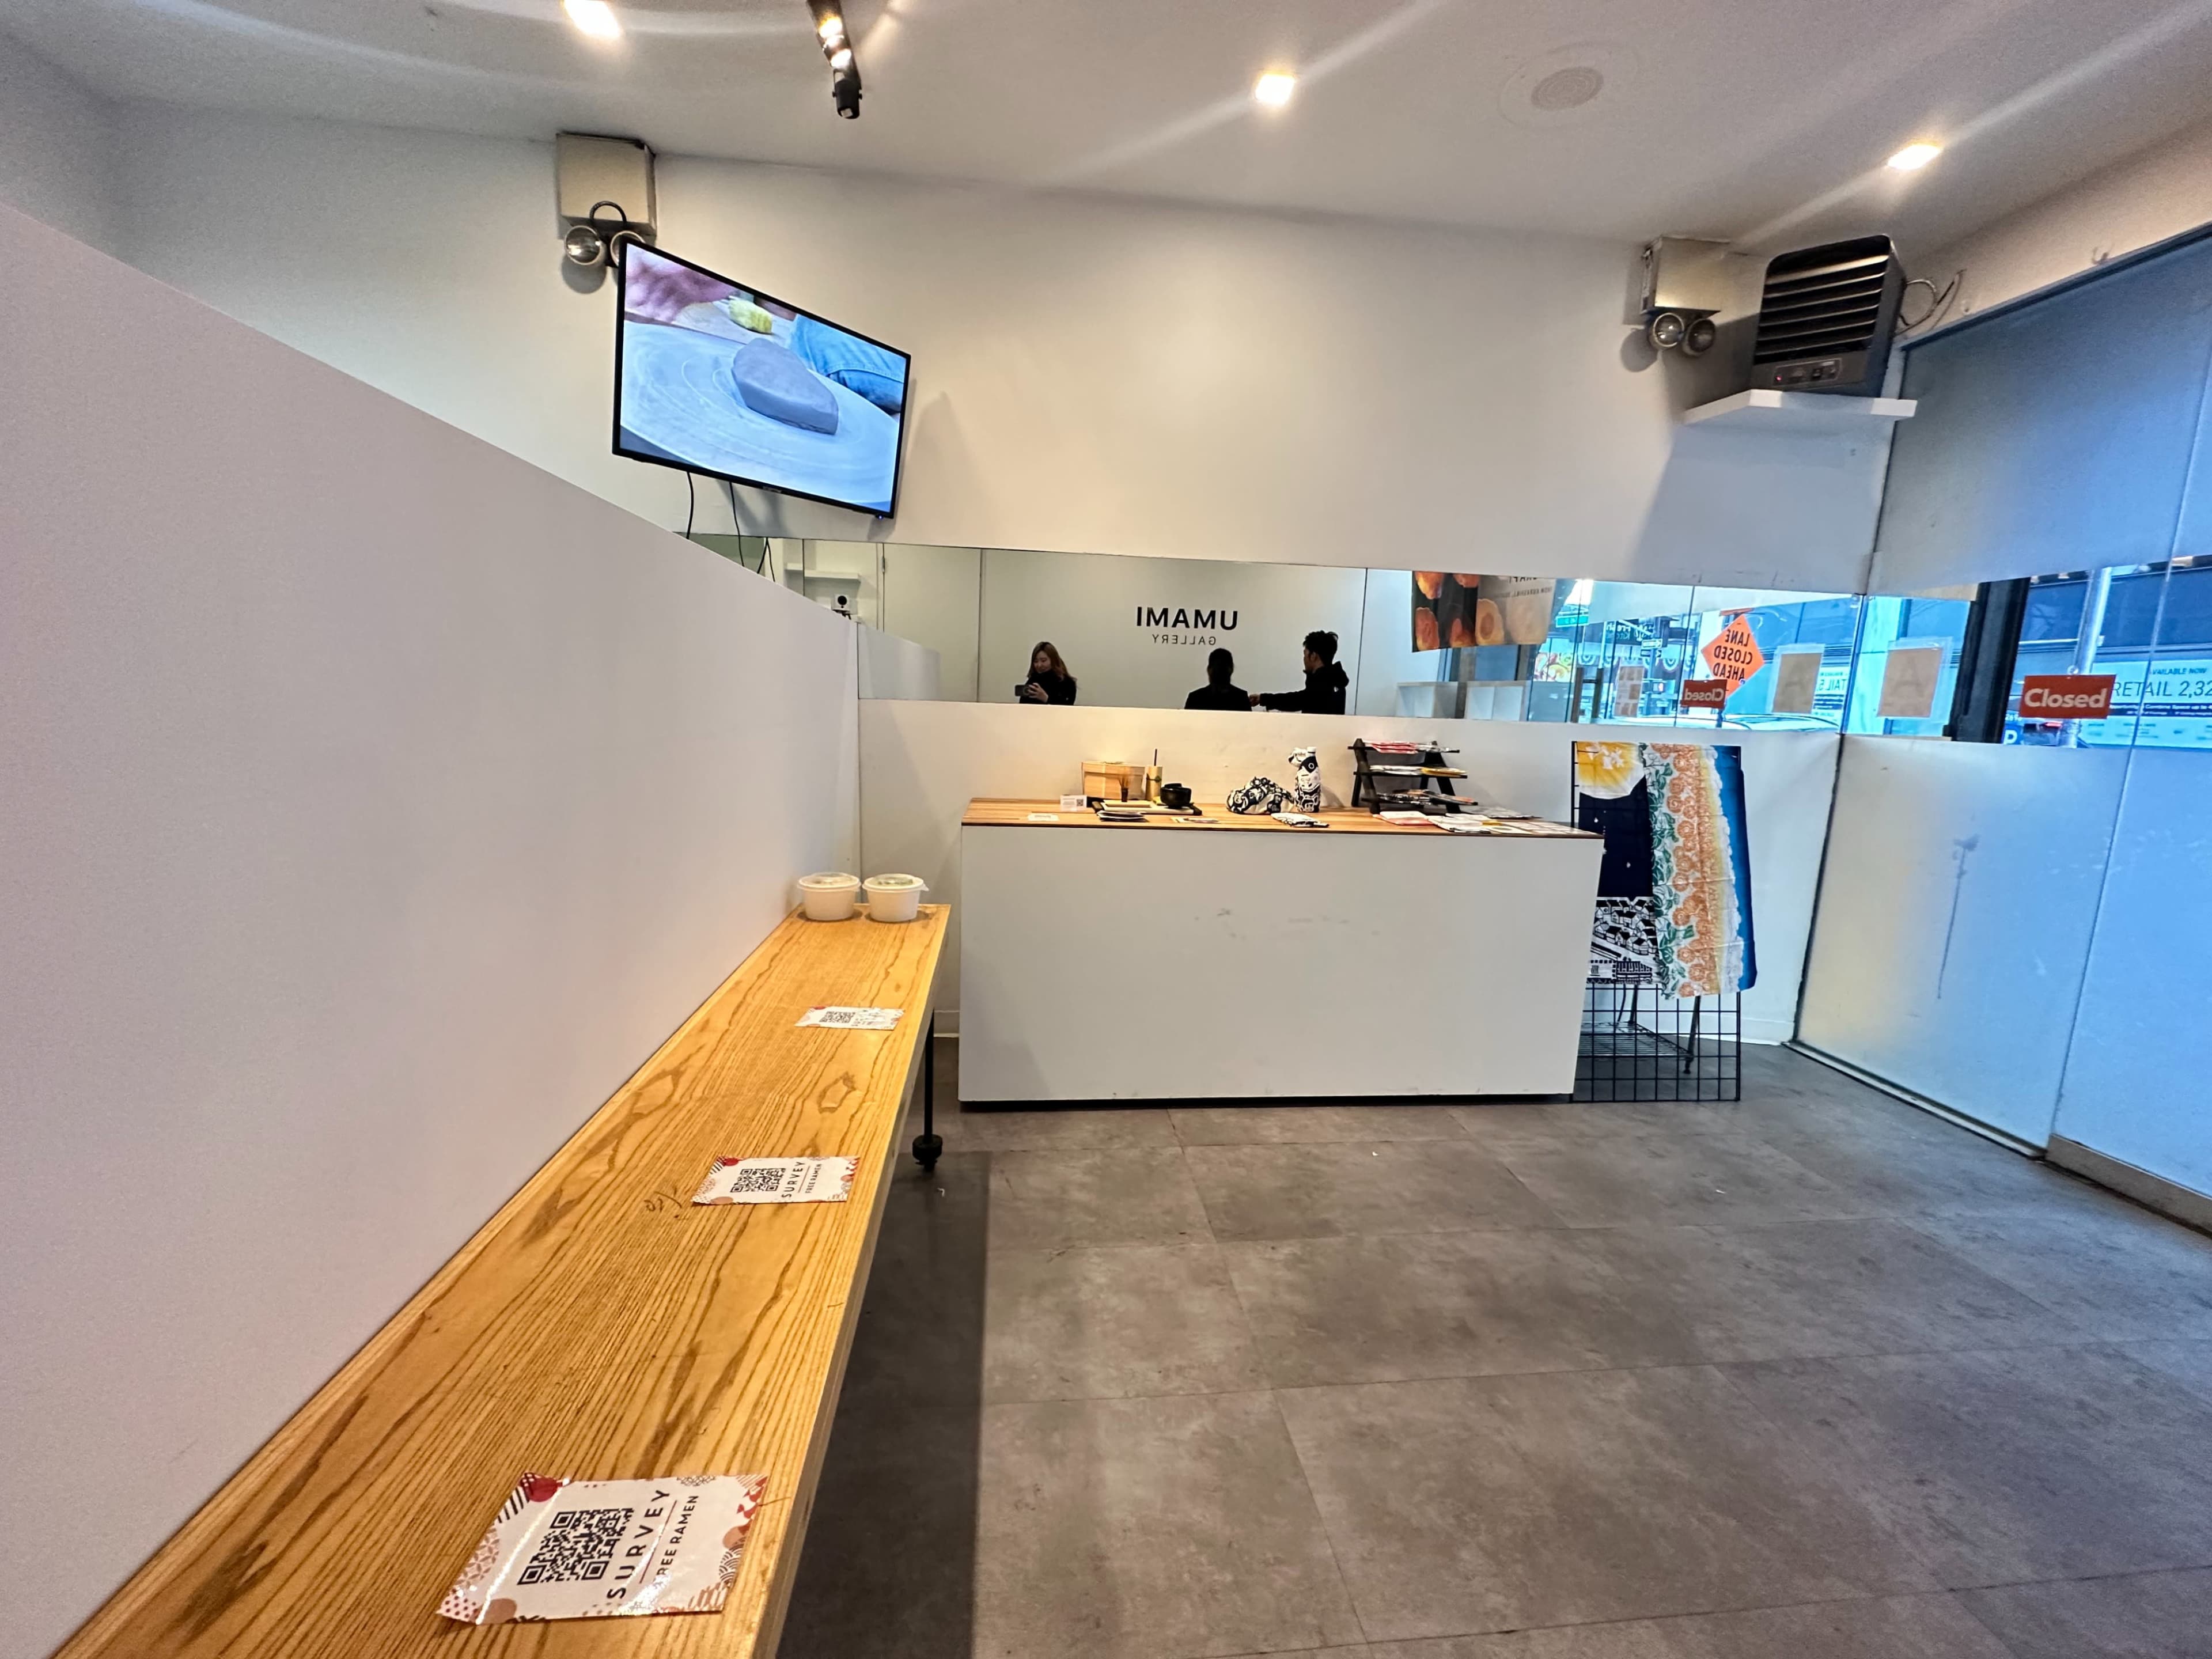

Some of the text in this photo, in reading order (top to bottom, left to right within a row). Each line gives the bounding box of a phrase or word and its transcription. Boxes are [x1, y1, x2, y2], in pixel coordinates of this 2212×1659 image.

[2024, 688, 2108, 709] Closed
[2113, 681, 2172, 696] RETAIL
[781, 1161, 805, 1198] SURVEY
[805, 1164, 822, 1194] FREE RAMEN
[606, 1490, 671, 1600] SURVEY
[653, 1495, 699, 1580] REE RAMEN
